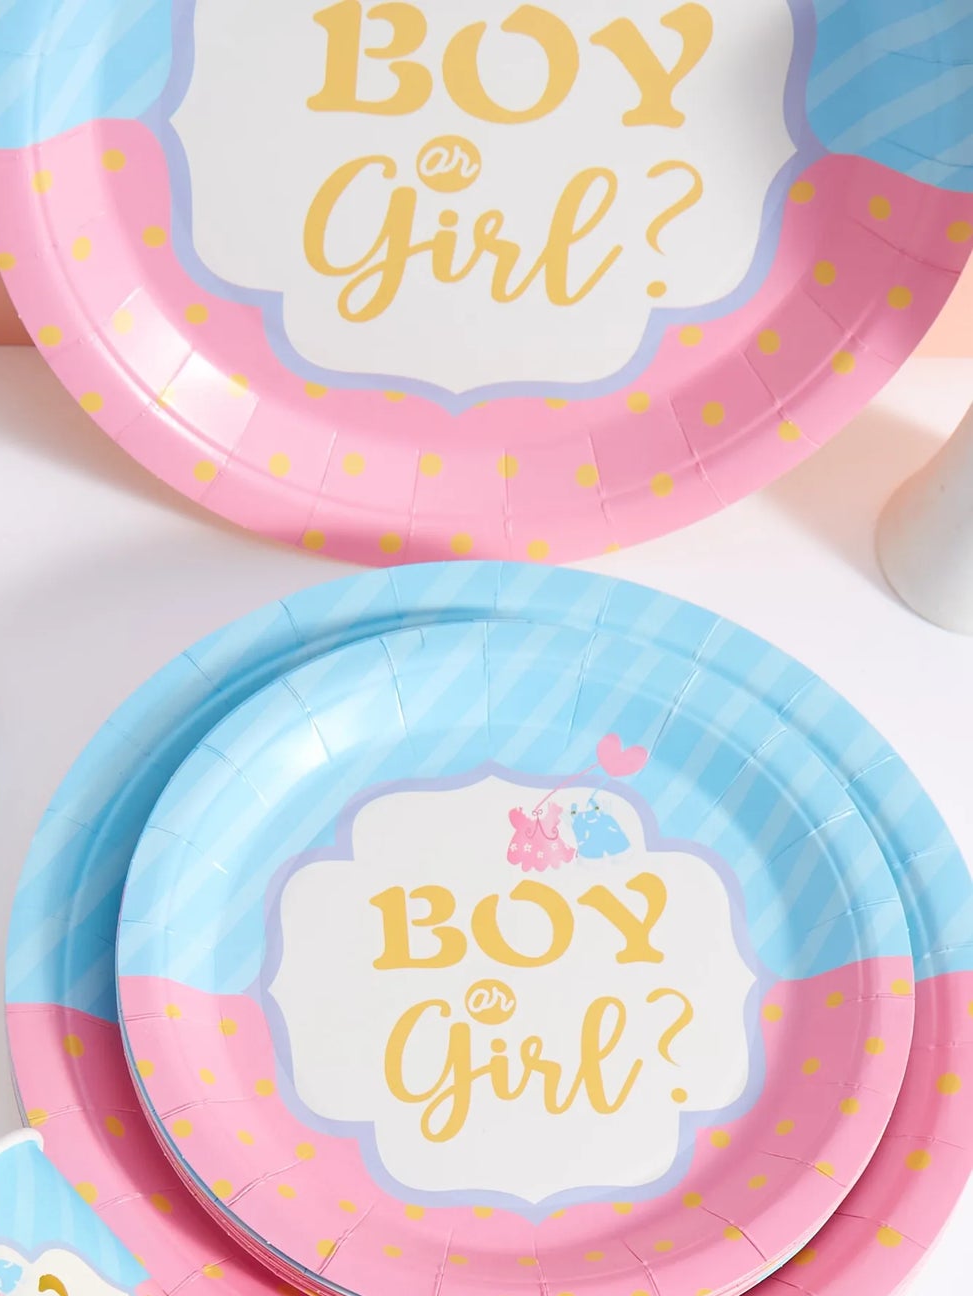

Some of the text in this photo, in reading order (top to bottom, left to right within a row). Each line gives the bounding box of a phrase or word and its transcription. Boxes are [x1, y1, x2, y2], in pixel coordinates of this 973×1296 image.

[306, 0, 714, 128] BOY
[419, 145, 480, 178] or
[303, 155, 703, 323] Girl?
[369, 872, 667, 970] BOY
[467, 986, 515, 1013] or
[384, 987, 694, 1143] Girl?
